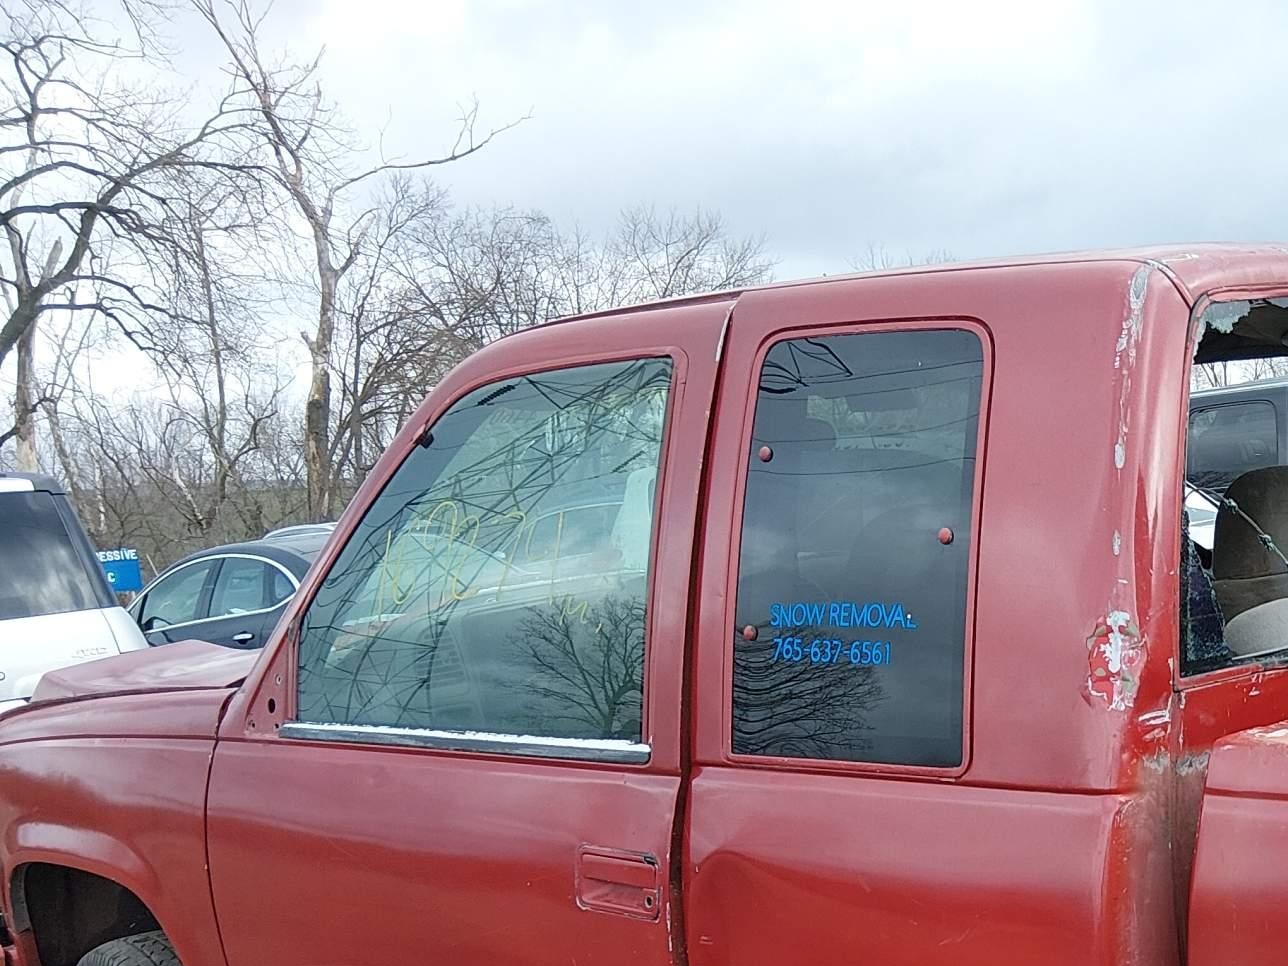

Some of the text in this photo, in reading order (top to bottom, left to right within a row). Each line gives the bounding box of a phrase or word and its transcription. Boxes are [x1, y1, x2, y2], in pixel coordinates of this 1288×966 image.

[770, 603, 917, 630] SNOW REMOVAL
[773, 637, 893, 665] 765-637-6561
